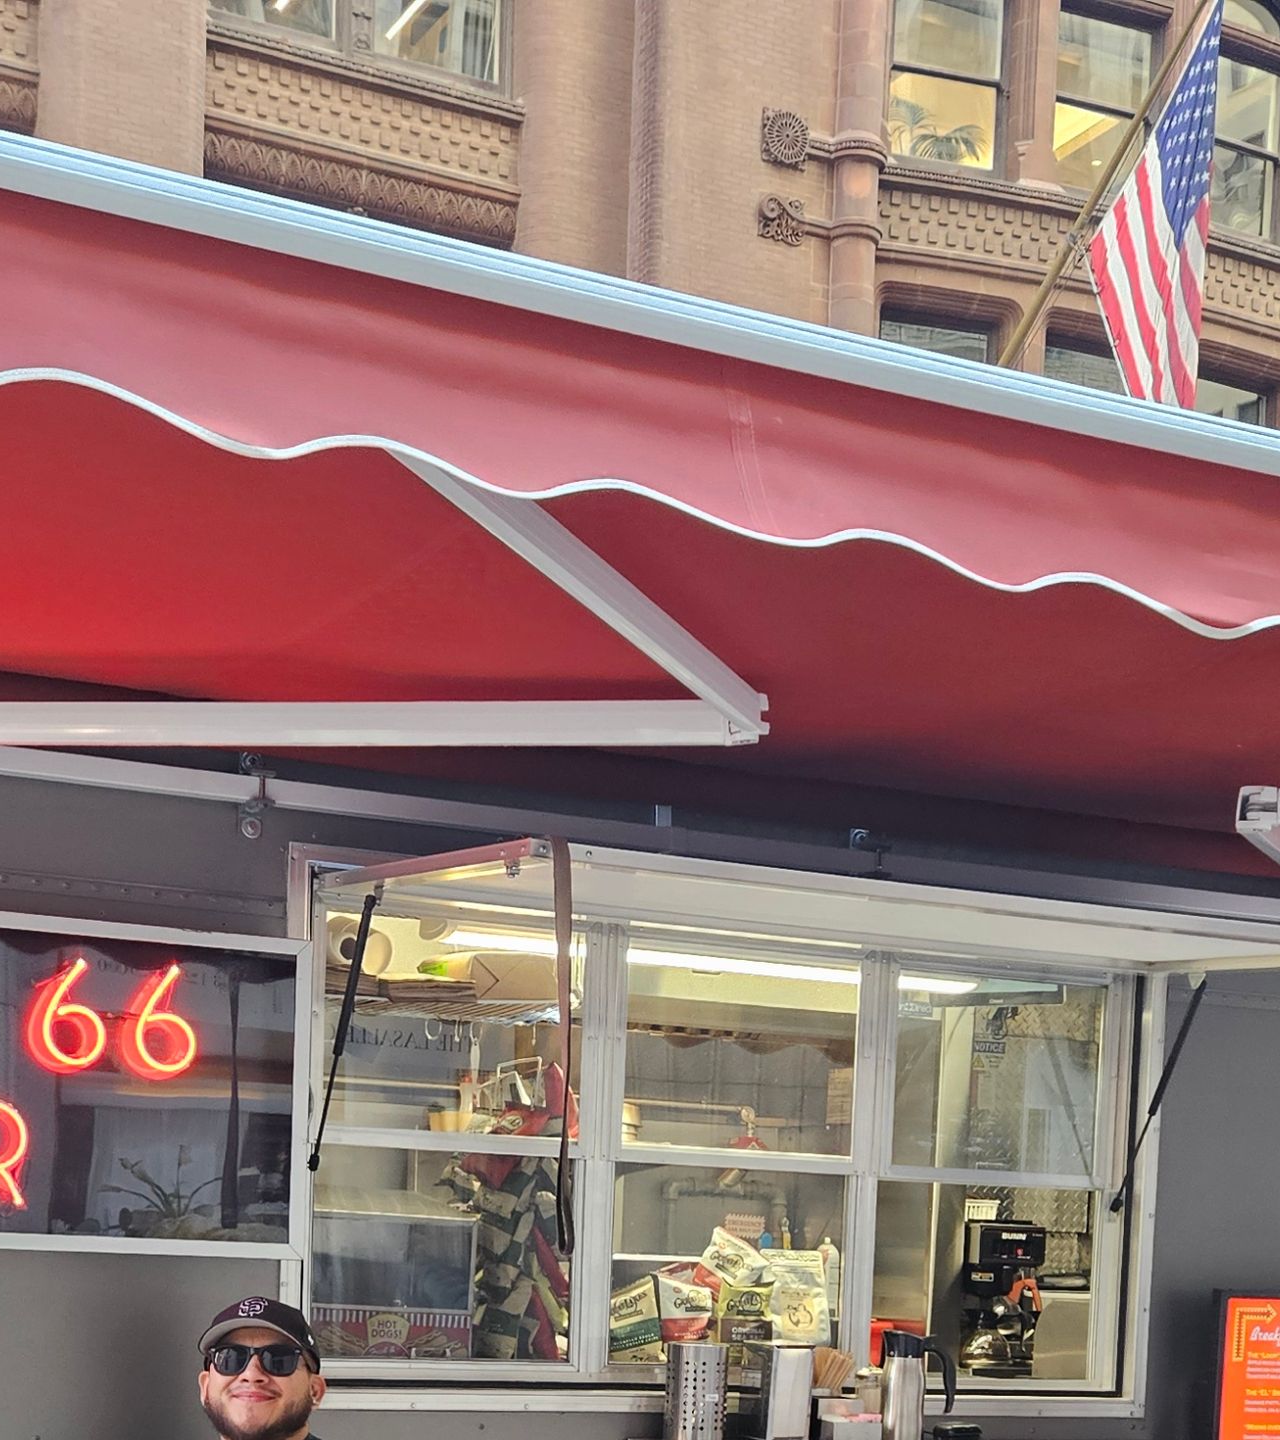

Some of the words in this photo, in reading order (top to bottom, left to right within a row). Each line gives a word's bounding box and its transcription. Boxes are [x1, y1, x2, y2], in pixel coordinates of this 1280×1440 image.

[26, 956, 197, 1080] 66
[974, 1042, 1005, 1052] NOTICE
[1001, 1232, 1027, 1240] BUNN
[377, 1319, 397, 1330] HOT
[371, 1328, 403, 1339] DOGS!
